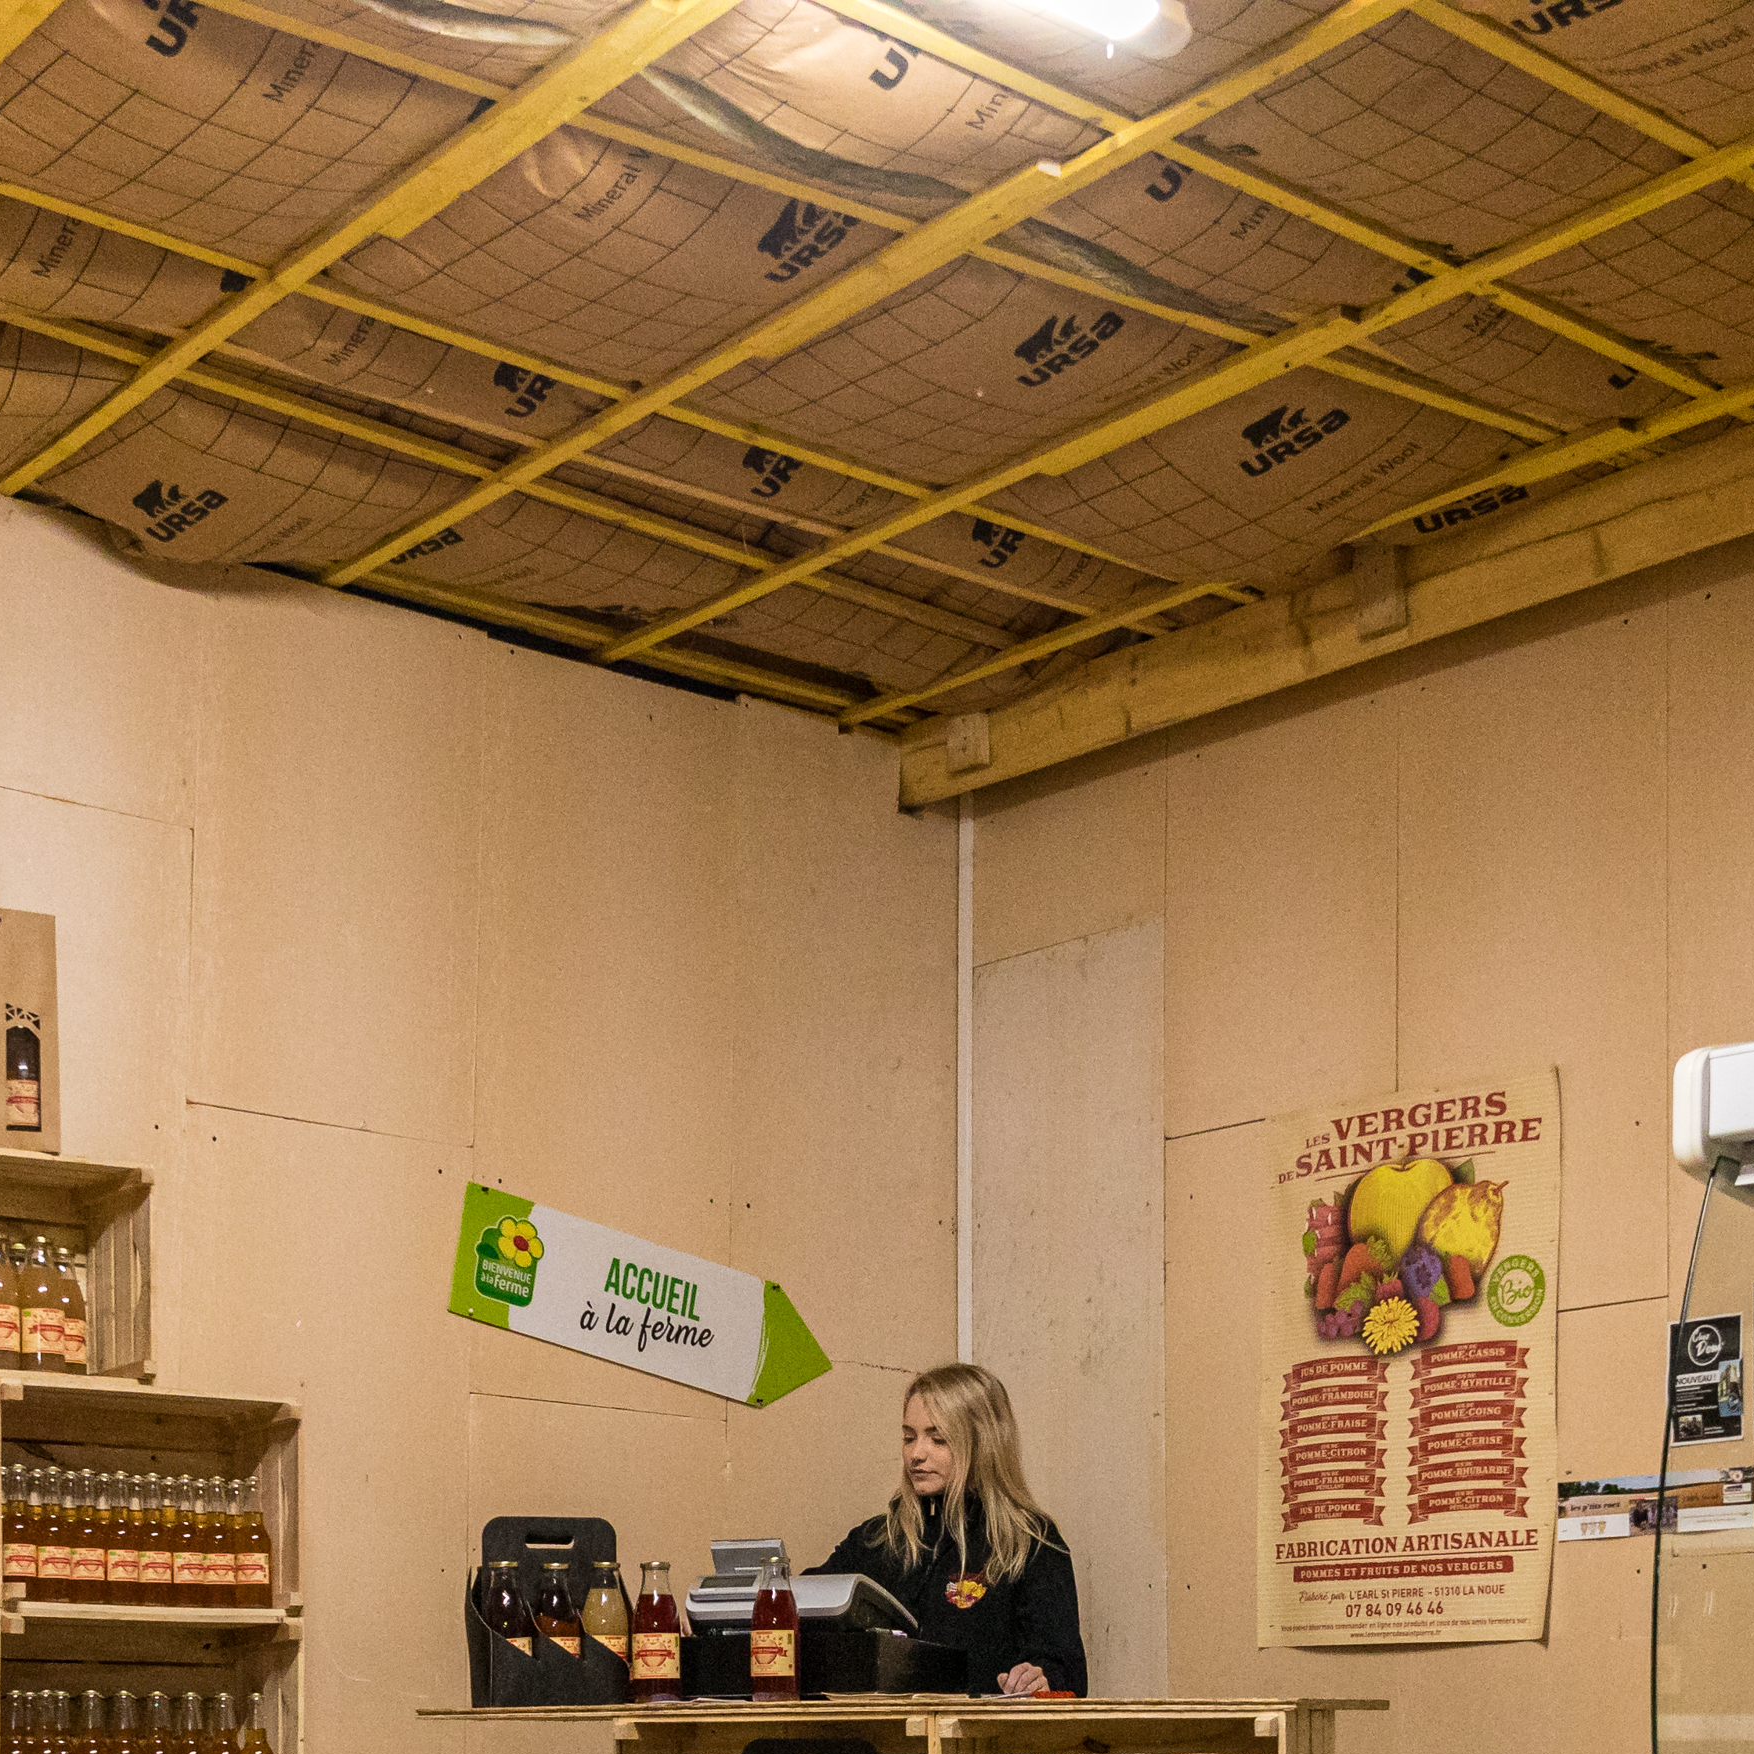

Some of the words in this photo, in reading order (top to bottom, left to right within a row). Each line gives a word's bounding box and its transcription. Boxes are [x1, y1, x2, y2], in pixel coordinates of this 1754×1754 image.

[263, 41, 321, 104] Minera
[31, 215, 80, 280] Minera
[323, 316, 376, 368] Minera
[1305, 1133, 1331, 1149] LES
[1330, 1091, 1508, 1141] VERGERS
[1278, 1171, 1294, 1185] DE
[482, 1259, 532, 1285] BIENVENUE
[494, 1275, 529, 1298] ferme
[604, 1258, 701, 1321] ACCUEIL
[1499, 1279, 1534, 1306] Bio
[579, 1301, 597, 1330] à
[605, 1303, 634, 1336] la
[635, 1307, 715, 1353] ferme
[1330, 1362, 1368, 1372] POMME
[1299, 1507, 1312, 1515] JUS
[1314, 1505, 1326, 1513] DE
[1328, 1503, 1361, 1512] POMME
[1275, 1536, 1397, 1559] FABRICATION
[1402, 1529, 1538, 1552] ARTISANALE
[1301, 1568, 1341, 1579] POMMES
[1344, 1568, 1357, 1577] ET
[1360, 1566, 1400, 1576] FRUITS
[1403, 1565, 1418, 1574] DE
[1421, 1563, 1444, 1573] NOS
[1446, 1561, 1503, 1572] VERGERS
[1349, 1589, 1379, 1600] L'EARL
[1392, 1588, 1423, 1598] PIERRE
[1434, 1586, 1460, 1596] 51310
[1463, 1586, 1475, 1596] LA
[1478, 1585, 1505, 1595] NOUE
[1346, 1604, 1361, 1618] 07
[1366, 1603, 1382, 1617] 84
[1386, 1602, 1402, 1616] 09
[1407, 1601, 1423, 1615] 46
[1427, 1601, 1444, 1615] 46
[1377, 1622, 1391, 1630] ligne
